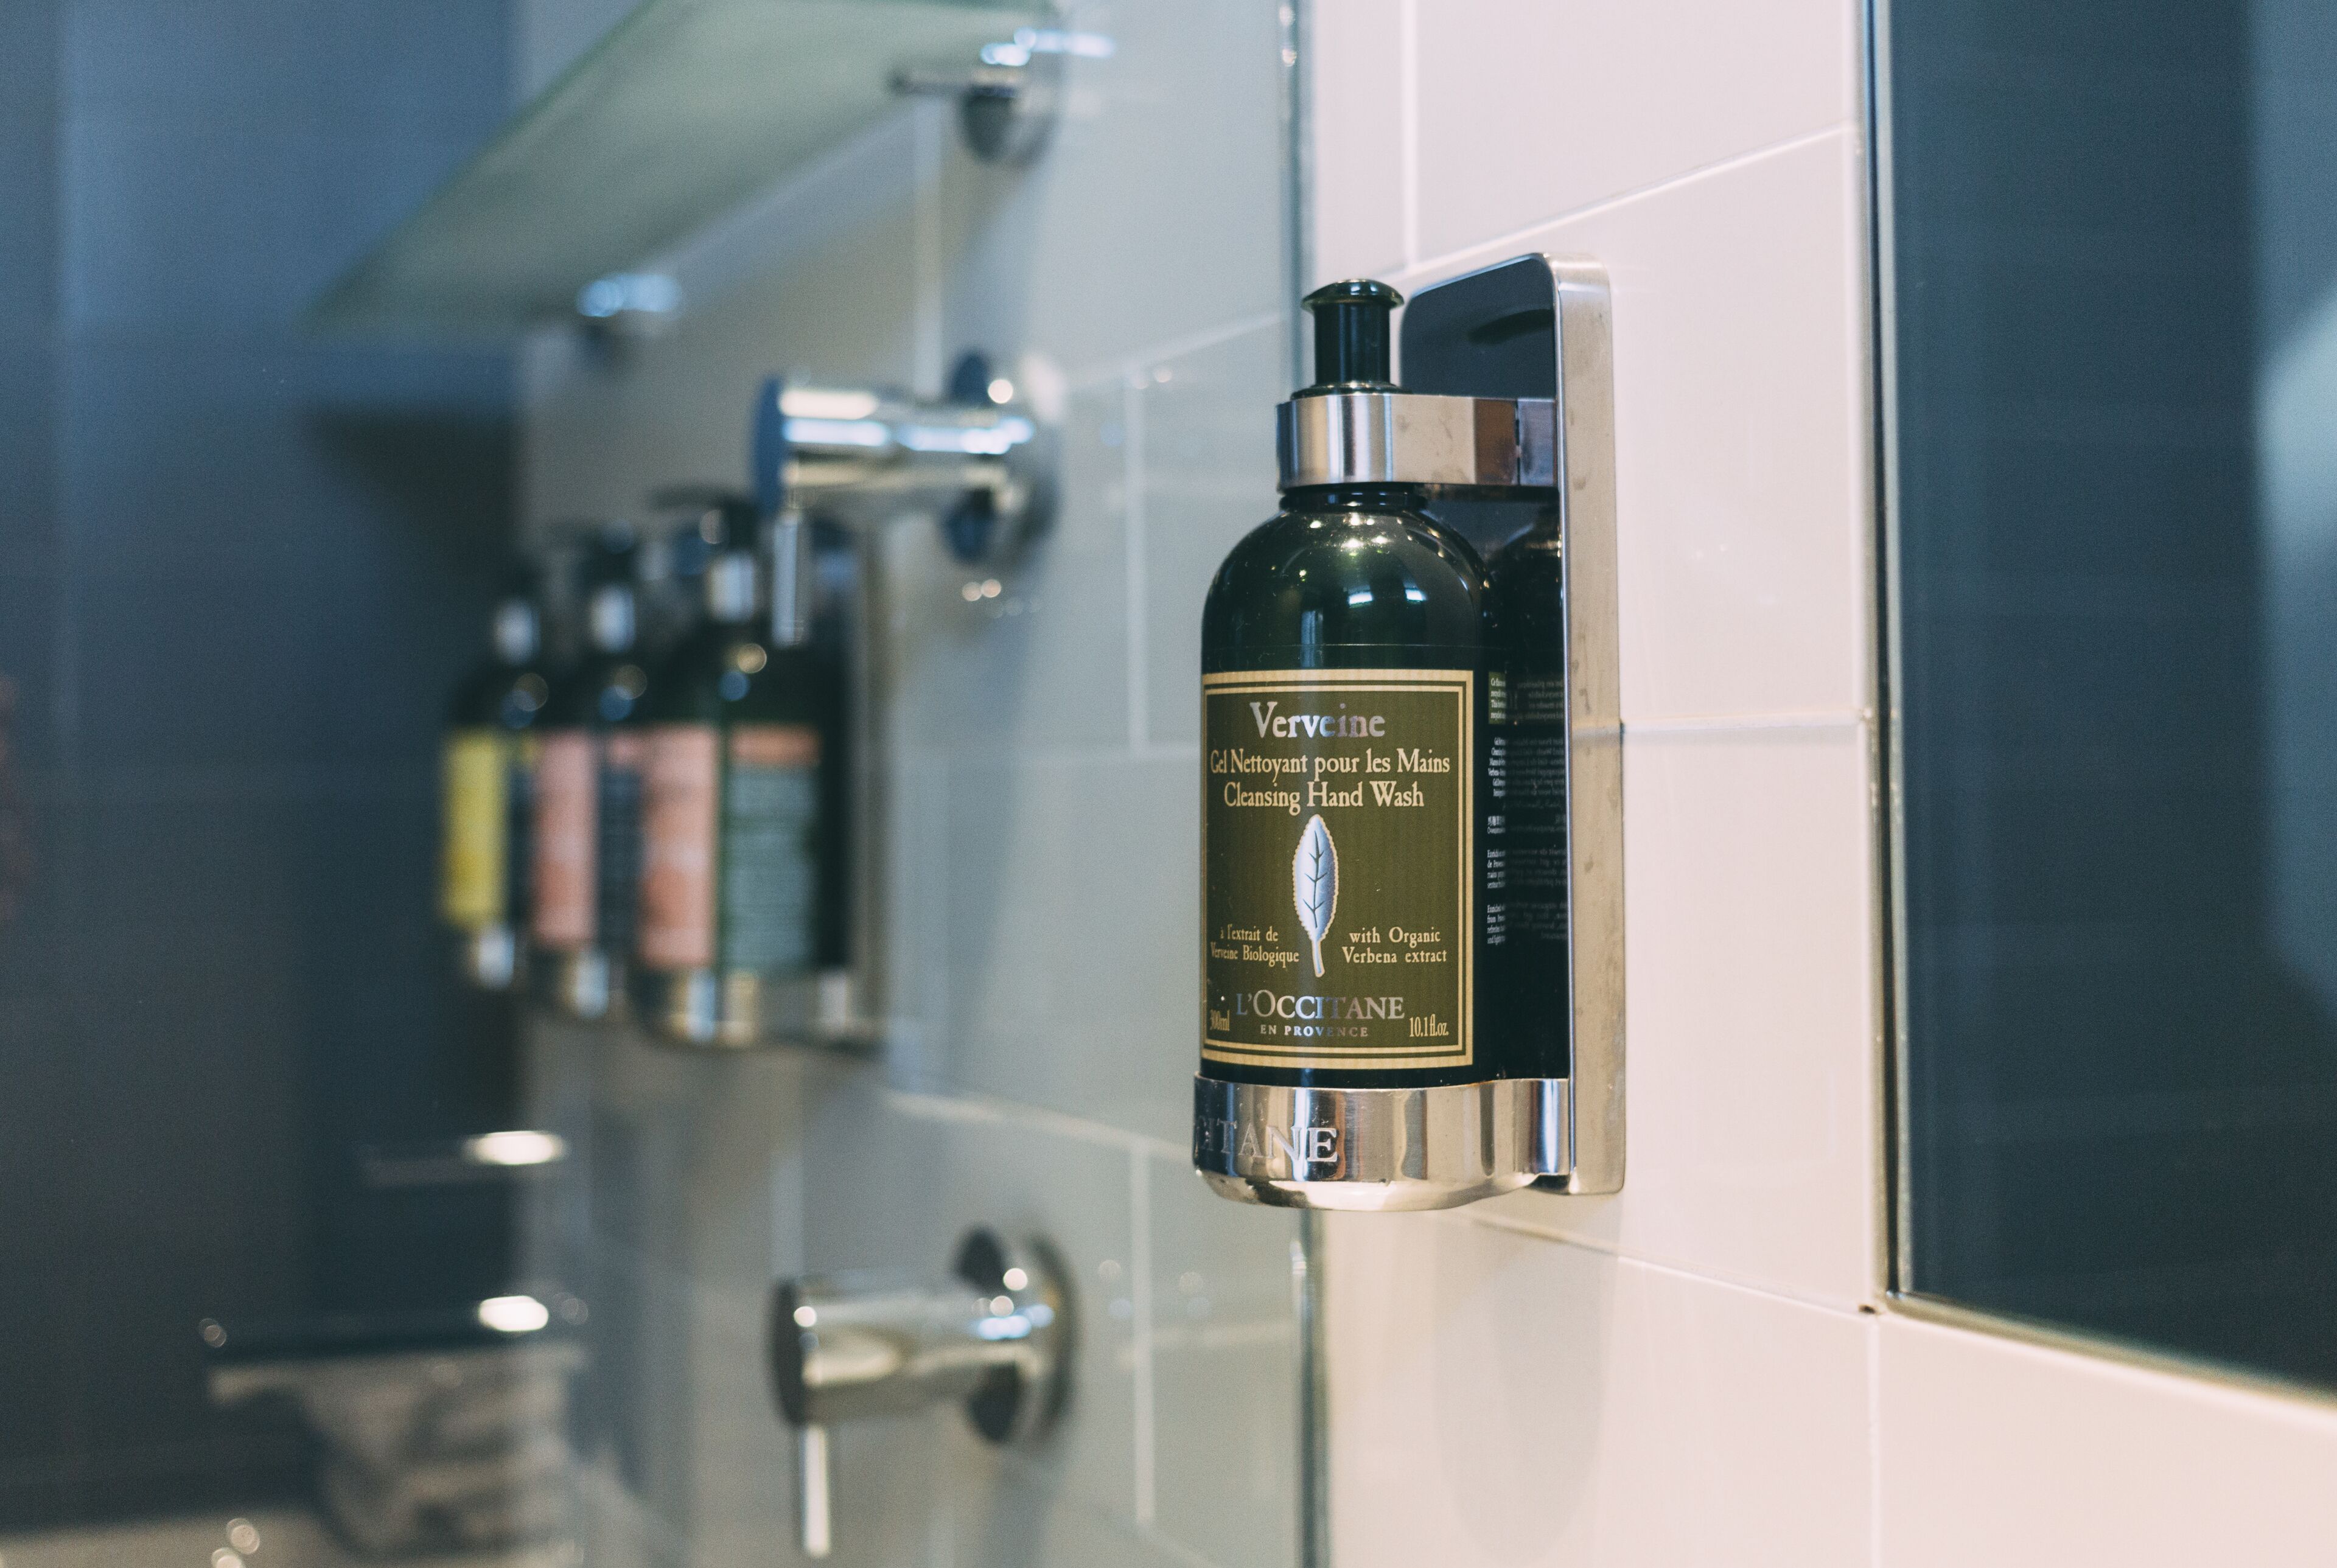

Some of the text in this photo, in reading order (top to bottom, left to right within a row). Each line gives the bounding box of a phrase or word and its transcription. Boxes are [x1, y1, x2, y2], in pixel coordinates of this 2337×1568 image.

[1249, 701, 1385, 739] Verveine
[1210, 748, 1450, 782] Gel Nettoyant pour les Mains
[1224, 781, 1424, 816] Cleansing Hand Wash
[1266, 925, 1278, 941] de
[1349, 927, 1441, 948] with Organic
[1243, 945, 1299, 967] Biologique
[1342, 946, 1447, 964] Verbena extract
[1236, 989, 1405, 1019] L'OCCITANE
[1260, 1025, 1368, 1037] EN PROVENCE
